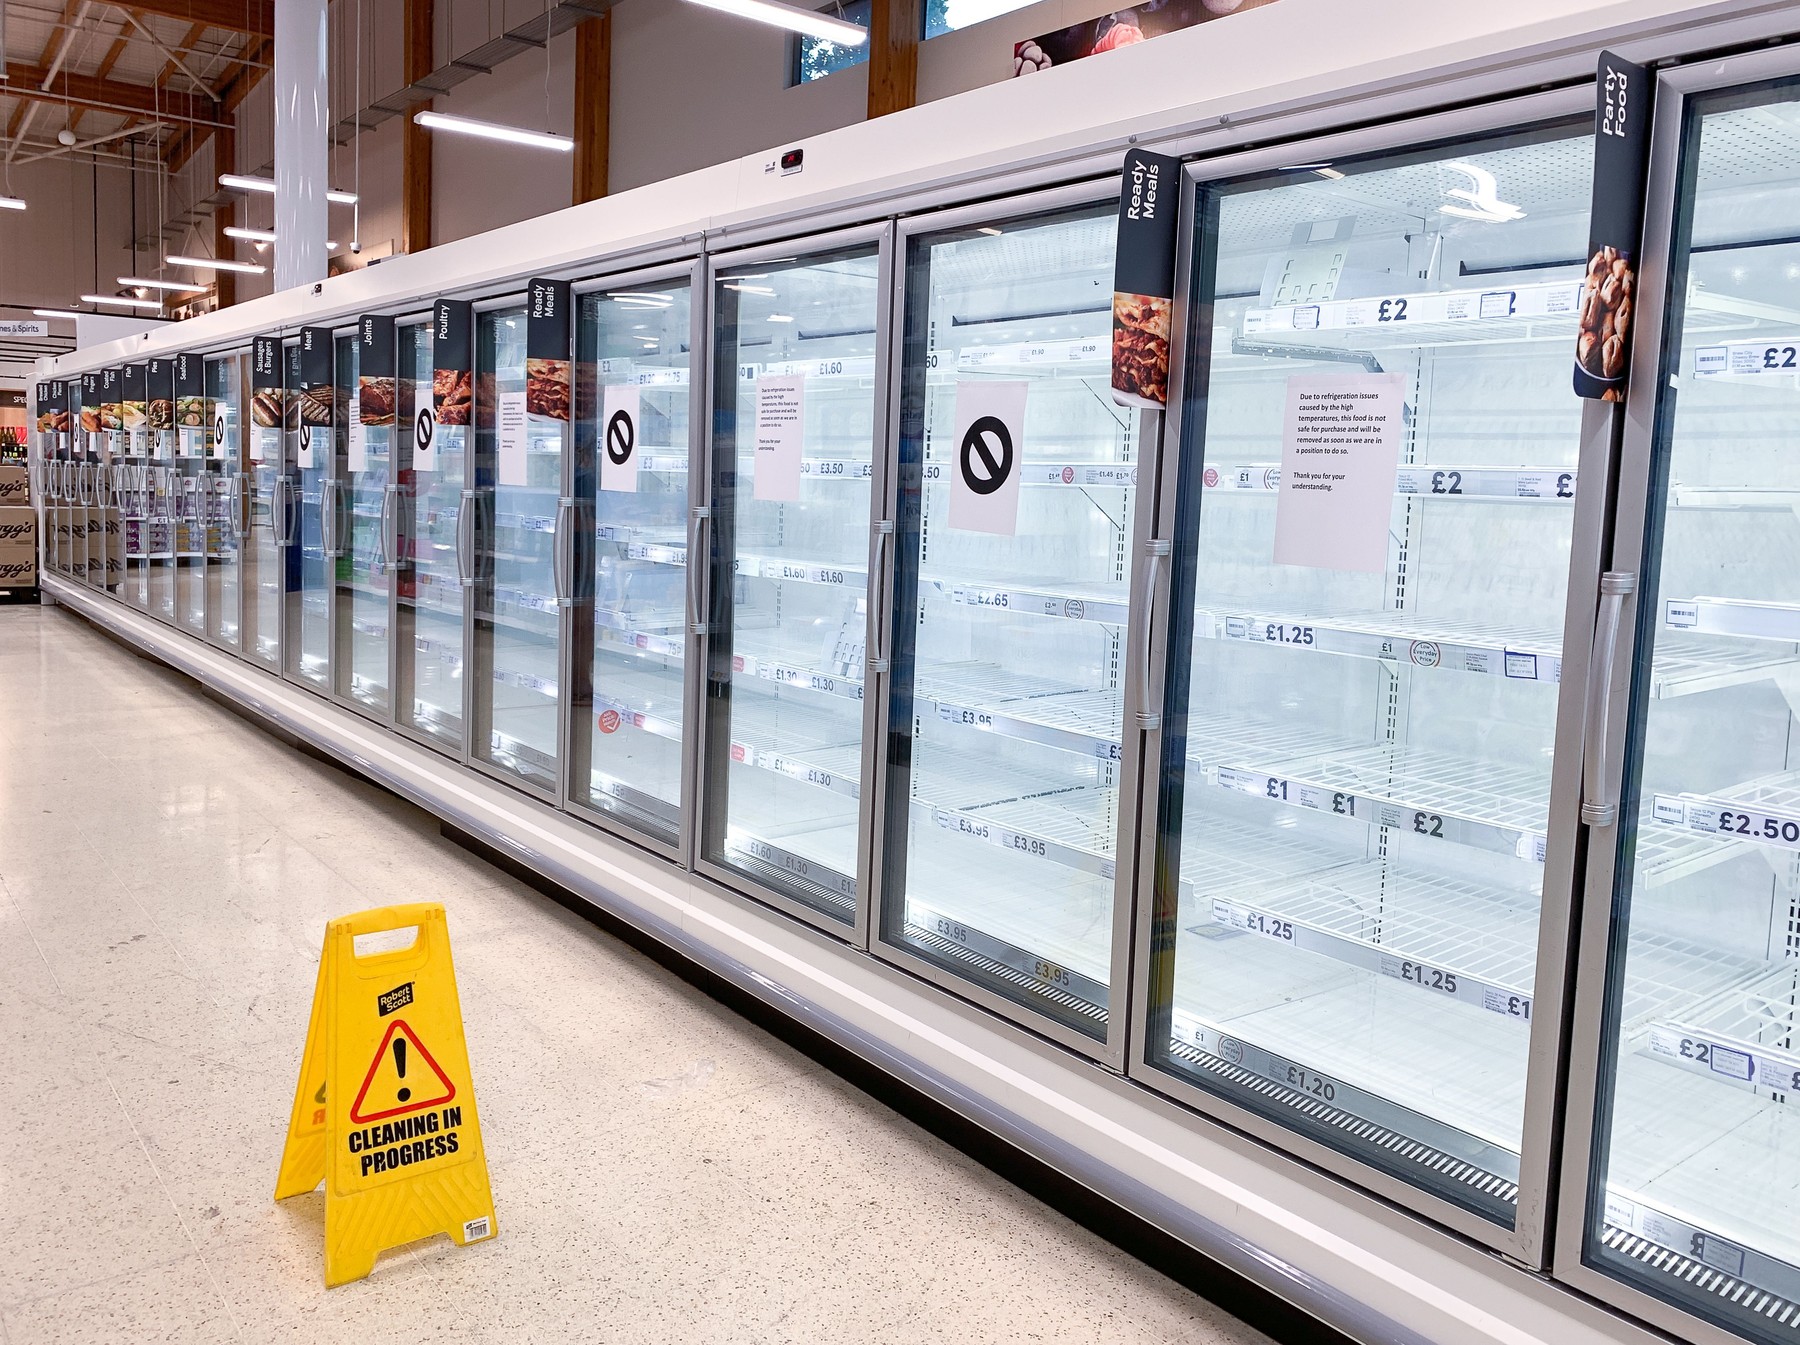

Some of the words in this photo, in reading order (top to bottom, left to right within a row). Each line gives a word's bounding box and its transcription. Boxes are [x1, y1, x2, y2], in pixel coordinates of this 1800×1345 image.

[1602, 65, 1617, 136] Party
[1615, 71, 1628, 138] Food
[1127, 159, 1147, 220] Ready
[1142, 164, 1159, 219] Meals
[533, 284, 545, 318] Ready
[544, 286, 555, 317] Meals
[1378, 298, 1408, 322] £2
[17, 324, 39, 334] Spirits
[364, 318, 373, 346] Joints
[438, 304, 451, 340] Poultry
[304, 331, 312, 351] Meat
[256, 340, 264, 373] Sausages
[264, 341, 272, 368] Burgers
[1763, 346, 1797, 369] £2
[820, 362, 842, 375] £1.60
[1321, 392, 1358, 401] refrigeration
[1359, 392, 1379, 400] issues
[1321, 404, 1328, 412] by
[1341, 404, 1353, 412] high
[1301, 447, 1323, 455] position
[820, 463, 844, 474] £3.50
[920, 466, 940, 478] .50
[1240, 473, 1249, 481] £1
[1292, 483, 1333, 492] understanding.
[1431, 471, 1463, 494] £2
[783, 566, 805, 579] £1.60
[821, 570, 844, 584] £1.60
[978, 590, 1008, 607] £2.65
[1266, 624, 1314, 645] £1.25
[1382, 642, 1392, 653] £1
[1413, 648, 1438, 658] Everyday
[811, 676, 834, 691] £1.30
[962, 710, 992, 728] £3.95
[808, 769, 831, 787] £1.30
[1266, 777, 1288, 801] £1
[1332, 792, 1355, 816] £1
[959, 818, 989, 838] £3.95
[1413, 811, 1444, 838] £2
[1718, 811, 1800, 843] £2.50
[750, 842, 772, 860] £1.60
[1013, 835, 1046, 856] £3.95
[785, 856, 808, 875] £1.30
[937, 919, 967, 942] £3.95
[1246, 912, 1293, 940] £1.25
[1034, 961, 1070, 986] £3.95
[1401, 961, 1457, 993] £1.25
[380, 986, 410, 1006] Robert
[386, 994, 411, 1012] Scott
[1507, 996, 1530, 1019] £1
[1195, 1031, 1204, 1042] £1
[1680, 1039, 1709, 1064] £2
[1286, 1066, 1335, 1101] £1.20
[348, 1112, 440, 1154] CLEANING
[442, 1106, 462, 1128] IN
[360, 1131, 459, 1177] PROGRESS
